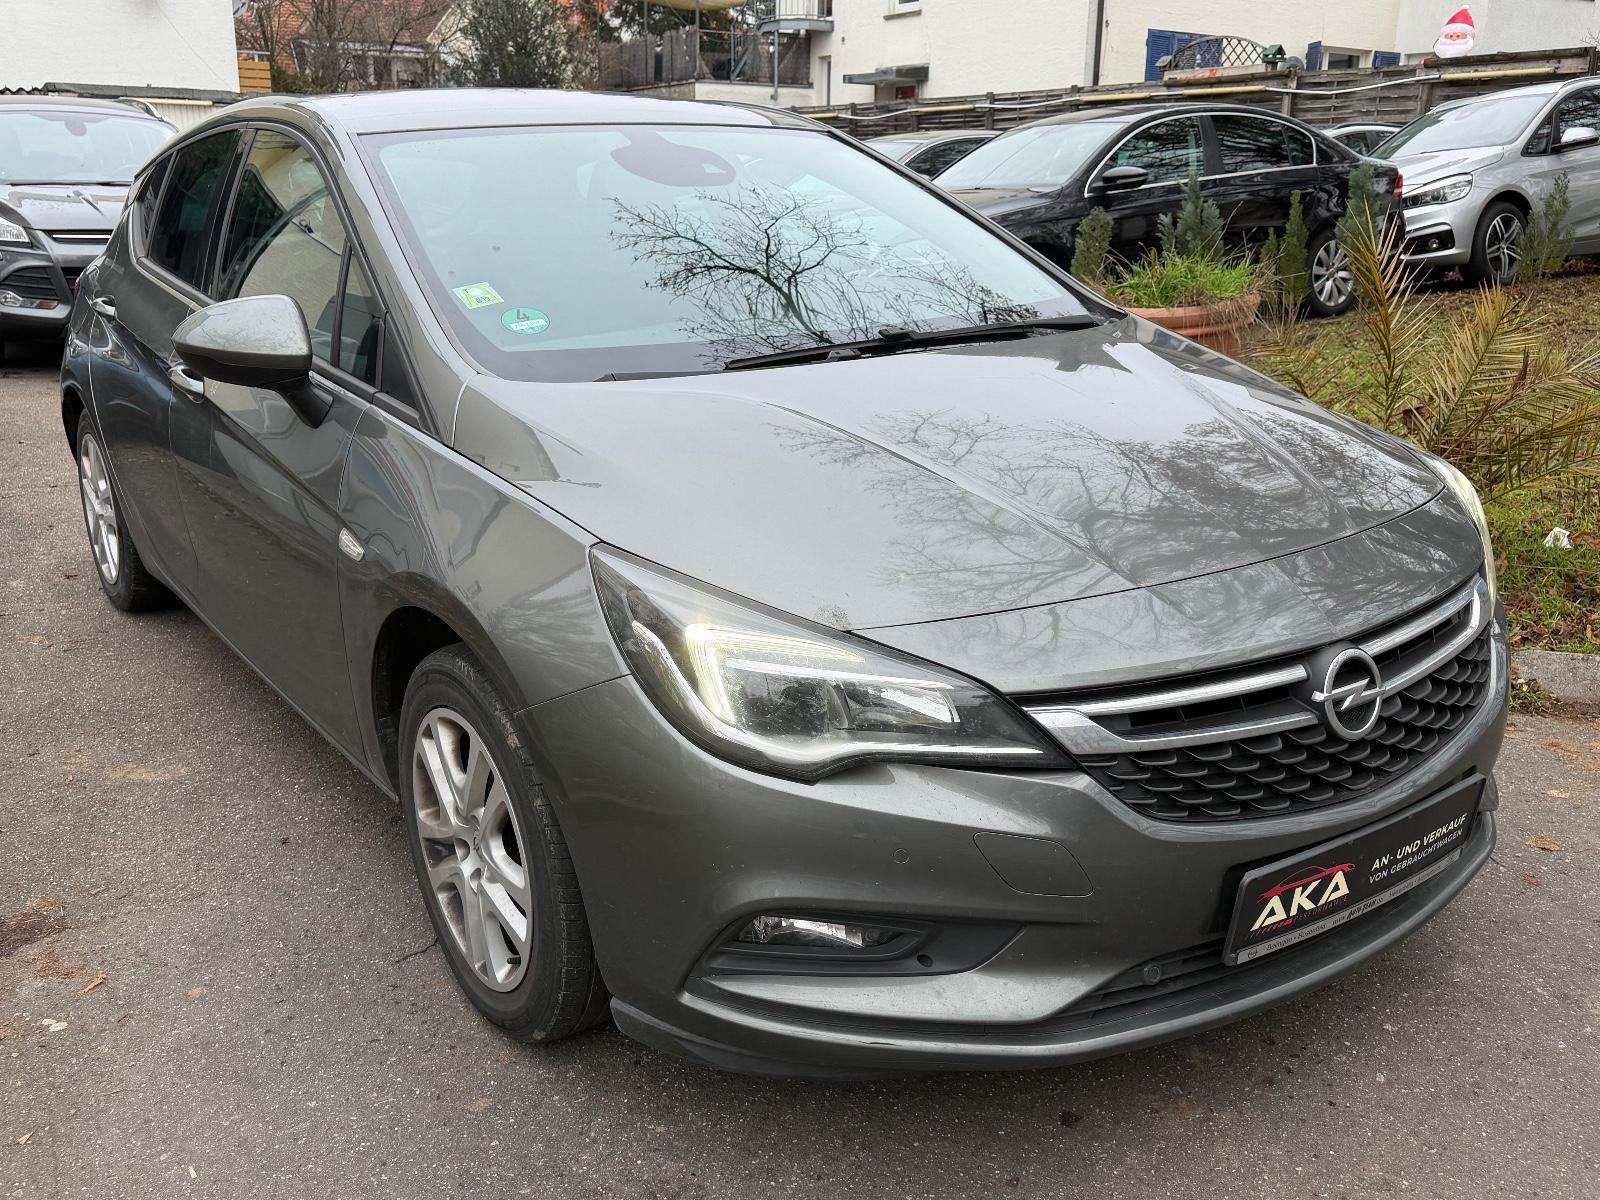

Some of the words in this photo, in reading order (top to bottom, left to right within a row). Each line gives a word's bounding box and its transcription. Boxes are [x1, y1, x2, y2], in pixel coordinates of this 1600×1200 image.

[516, 309, 529, 320] 4
[1369, 868, 1389, 884] VON
[1390, 829, 1463, 874] GEBRAUCHTWAGEN
[1371, 853, 1394, 871] AN-
[1396, 840, 1421, 860] UND
[1423, 813, 1467, 846] VERKAUF
[1250, 870, 1350, 932] AKA
